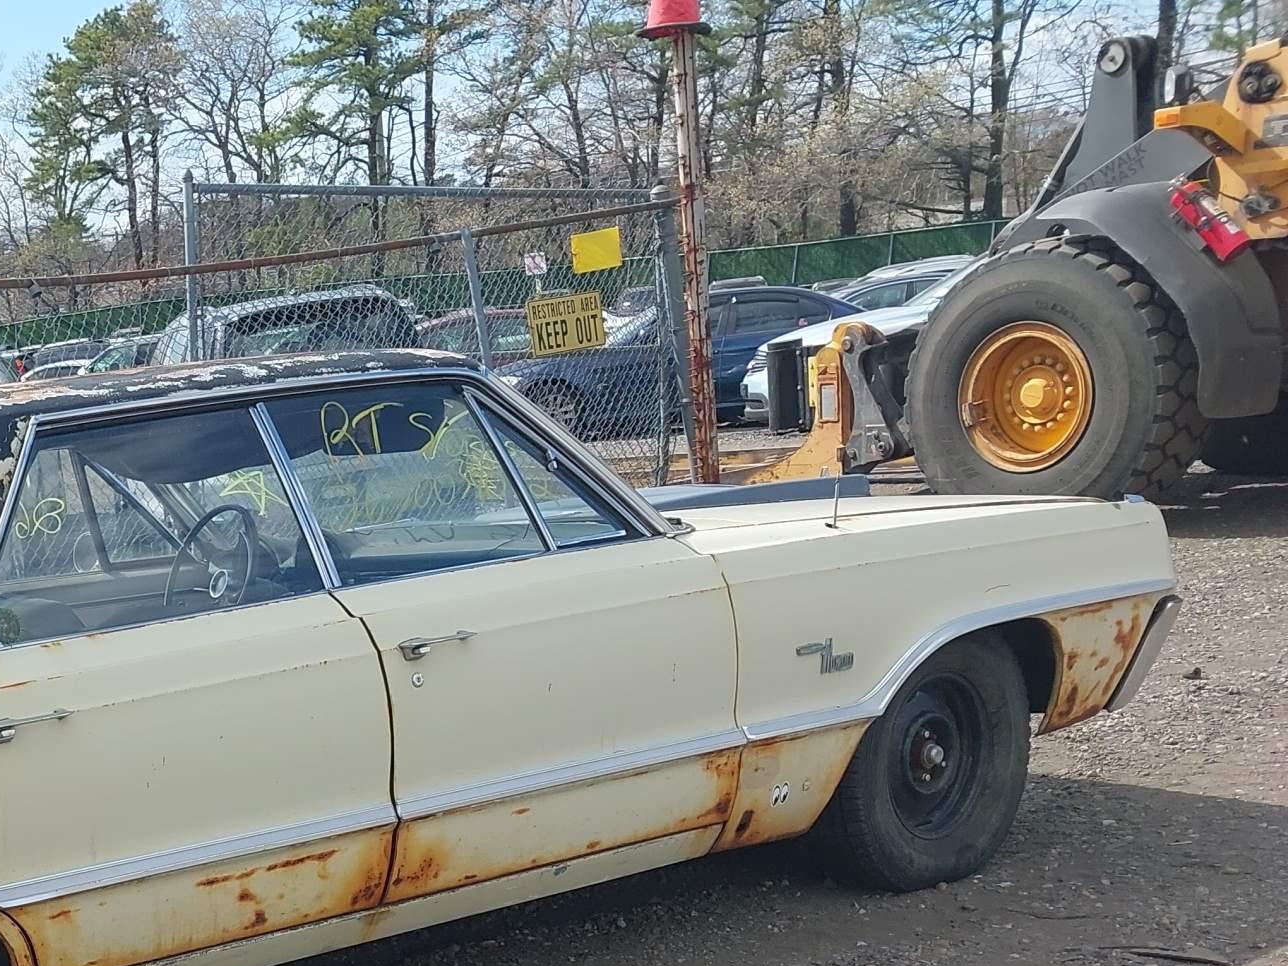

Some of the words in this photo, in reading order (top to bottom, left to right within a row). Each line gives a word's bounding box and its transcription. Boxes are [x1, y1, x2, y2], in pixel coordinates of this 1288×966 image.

[1098, 142, 1147, 177] WALK
[533, 301, 575, 320] RESTRICTED
[580, 296, 599, 312] AREA
[536, 320, 568, 351] KEEP
[575, 314, 599, 345] OUT
